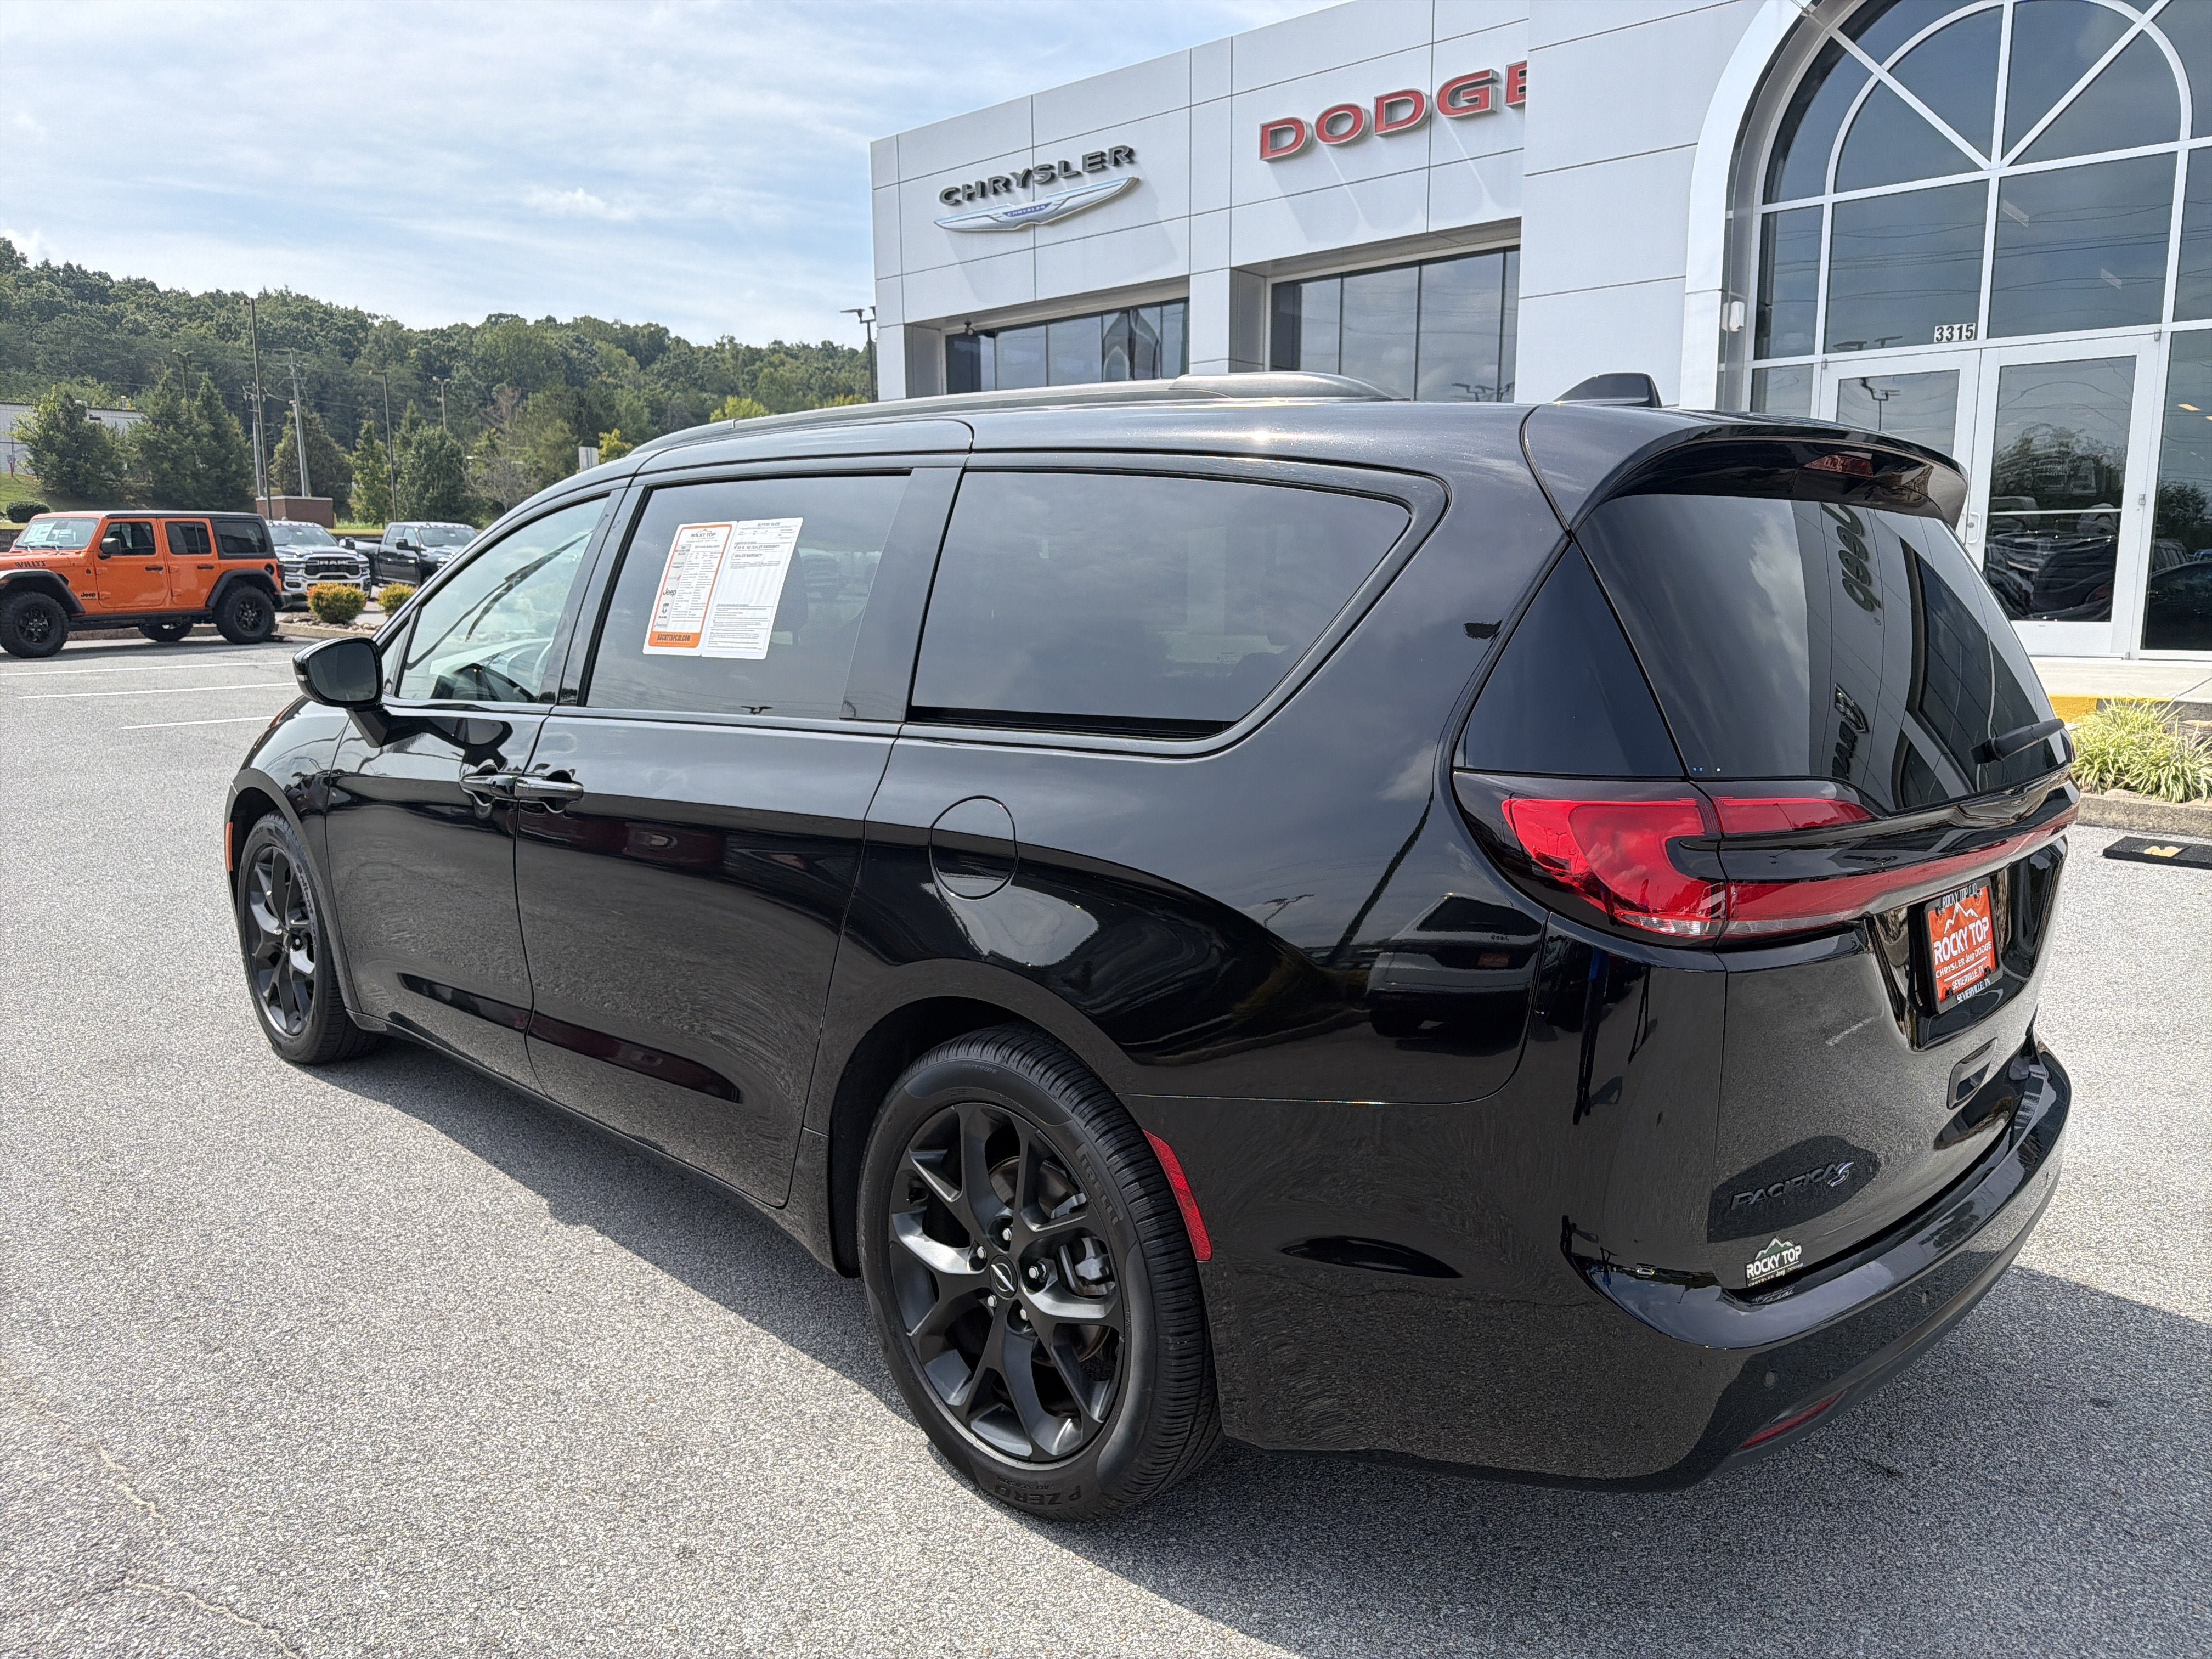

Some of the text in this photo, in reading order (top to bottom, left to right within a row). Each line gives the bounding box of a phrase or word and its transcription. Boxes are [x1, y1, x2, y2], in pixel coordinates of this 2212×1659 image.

[939, 145, 1135, 206] CHRYSLER
[1936, 324, 1974, 342] 3315
[663, 588, 677, 597] Jeep
[1942, 891, 1959, 909] ROCKY
[1959, 887, 1968, 900] TOP
[1933, 916, 1989, 966] ROCKY TOP
[1936, 940, 1992, 979] CHRYSLER Jeep DODGE
[1978, 964, 1984, 975] TN
[1984, 977, 1991, 988] TN
[1075, 1142, 1124, 1226] PIRELLI
[1729, 1163, 1838, 1210] PACIFICA
[1746, 1245, 1802, 1279] ROCKY TOP
[1748, 1274, 1774, 1287] CHRYSLER
[994, 1483, 1082, 1505] P ZERO
